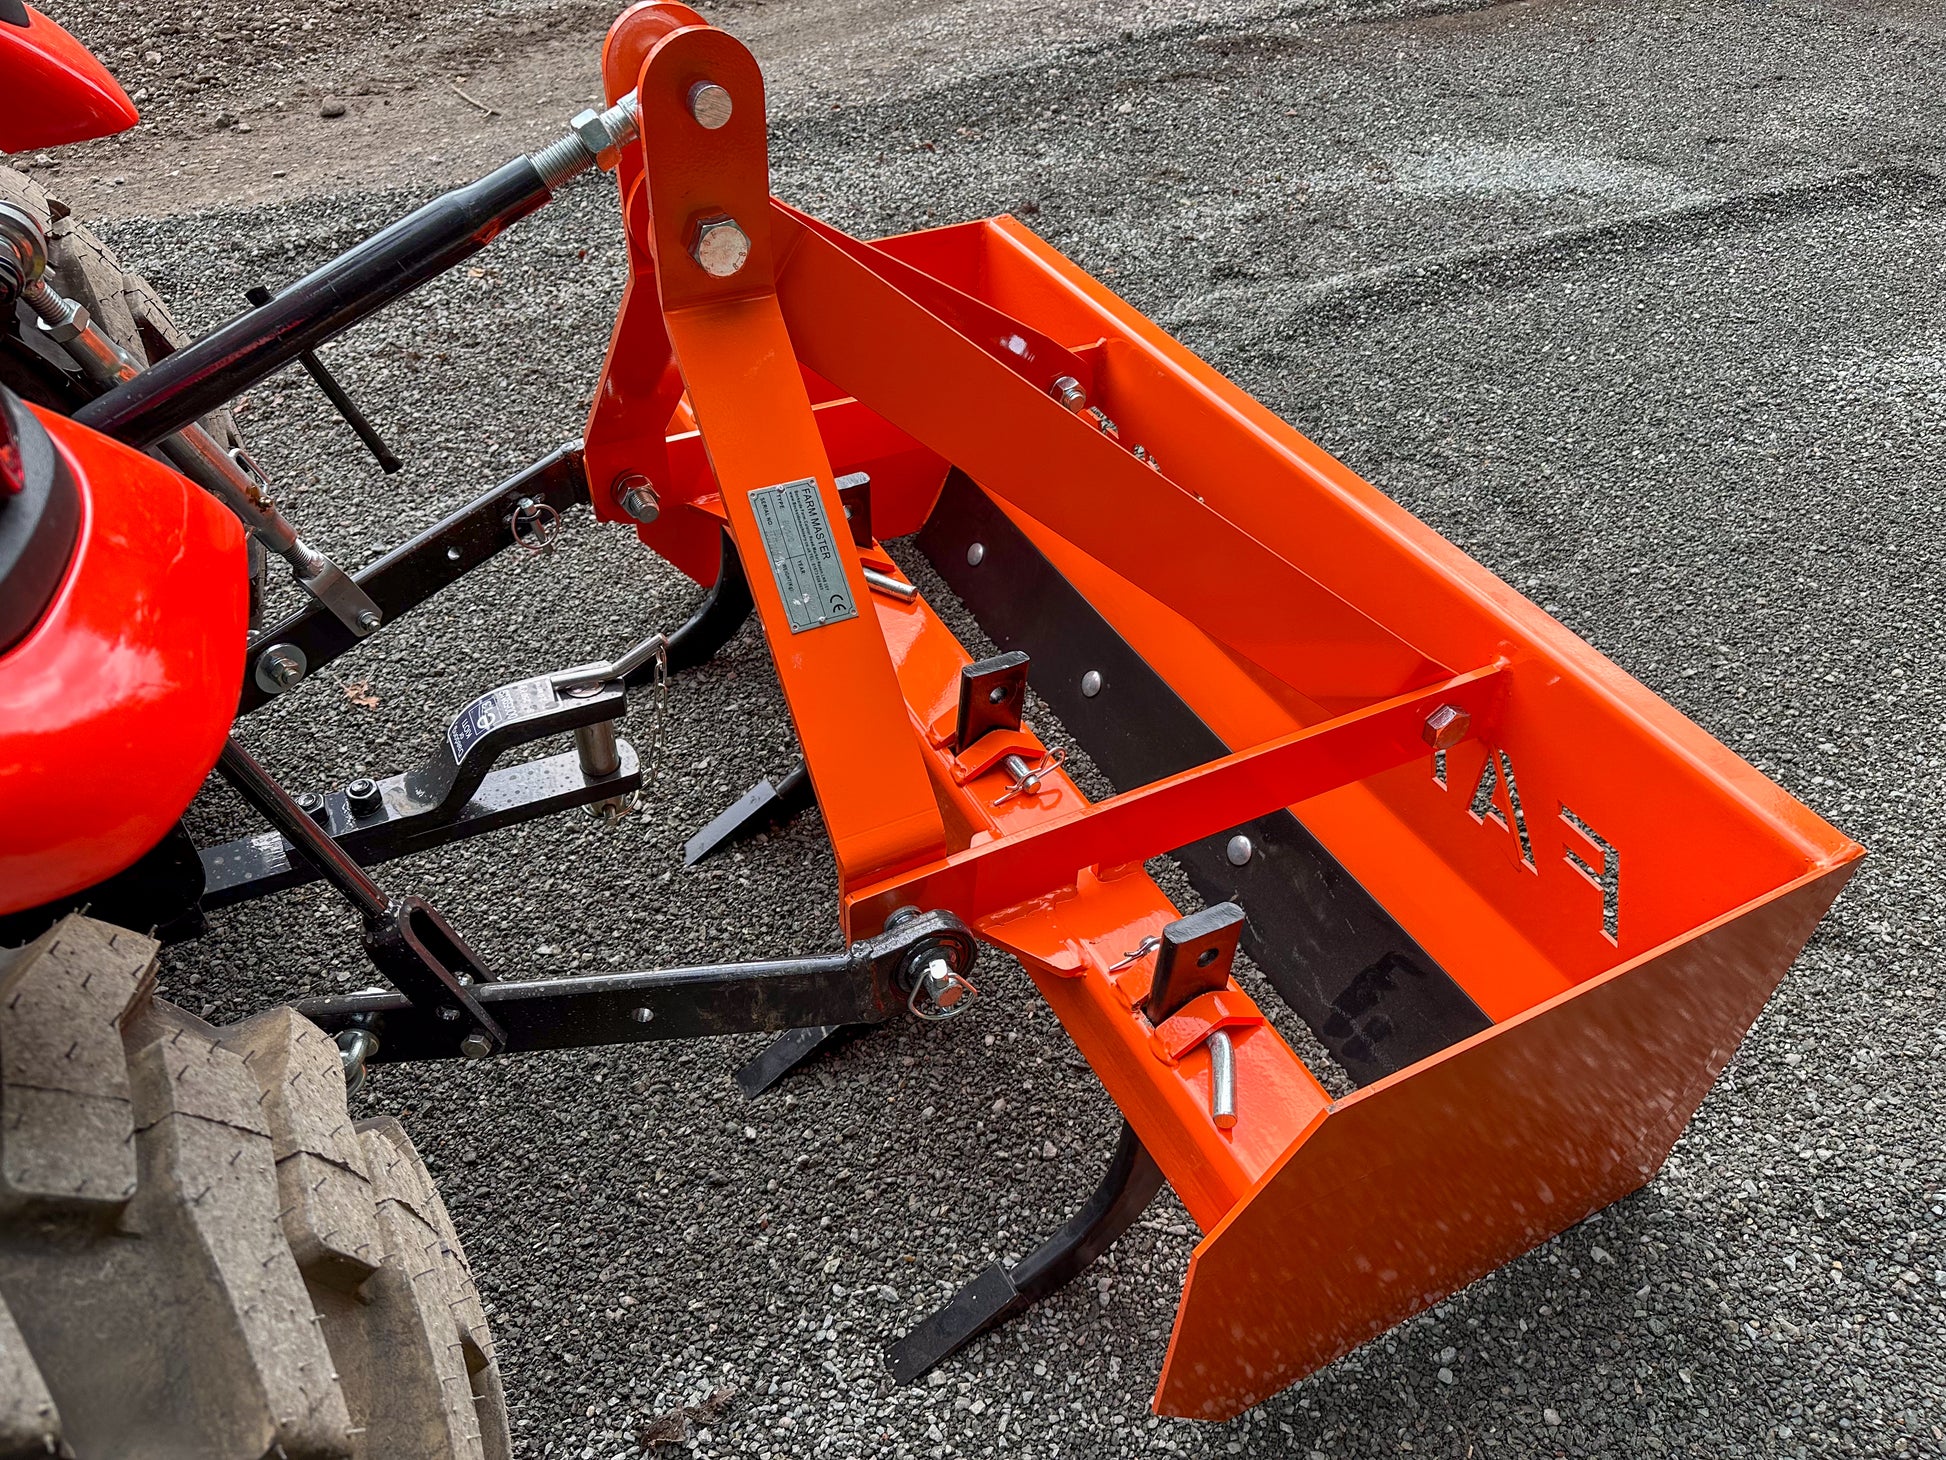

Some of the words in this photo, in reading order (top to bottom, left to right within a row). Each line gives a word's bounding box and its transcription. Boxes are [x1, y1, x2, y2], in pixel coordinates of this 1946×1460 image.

[759, 497, 770, 516] SERIAL
[801, 488, 818, 517] FARM
[810, 517, 831, 560] MASTER
[462, 718, 473, 739] KIOTI
